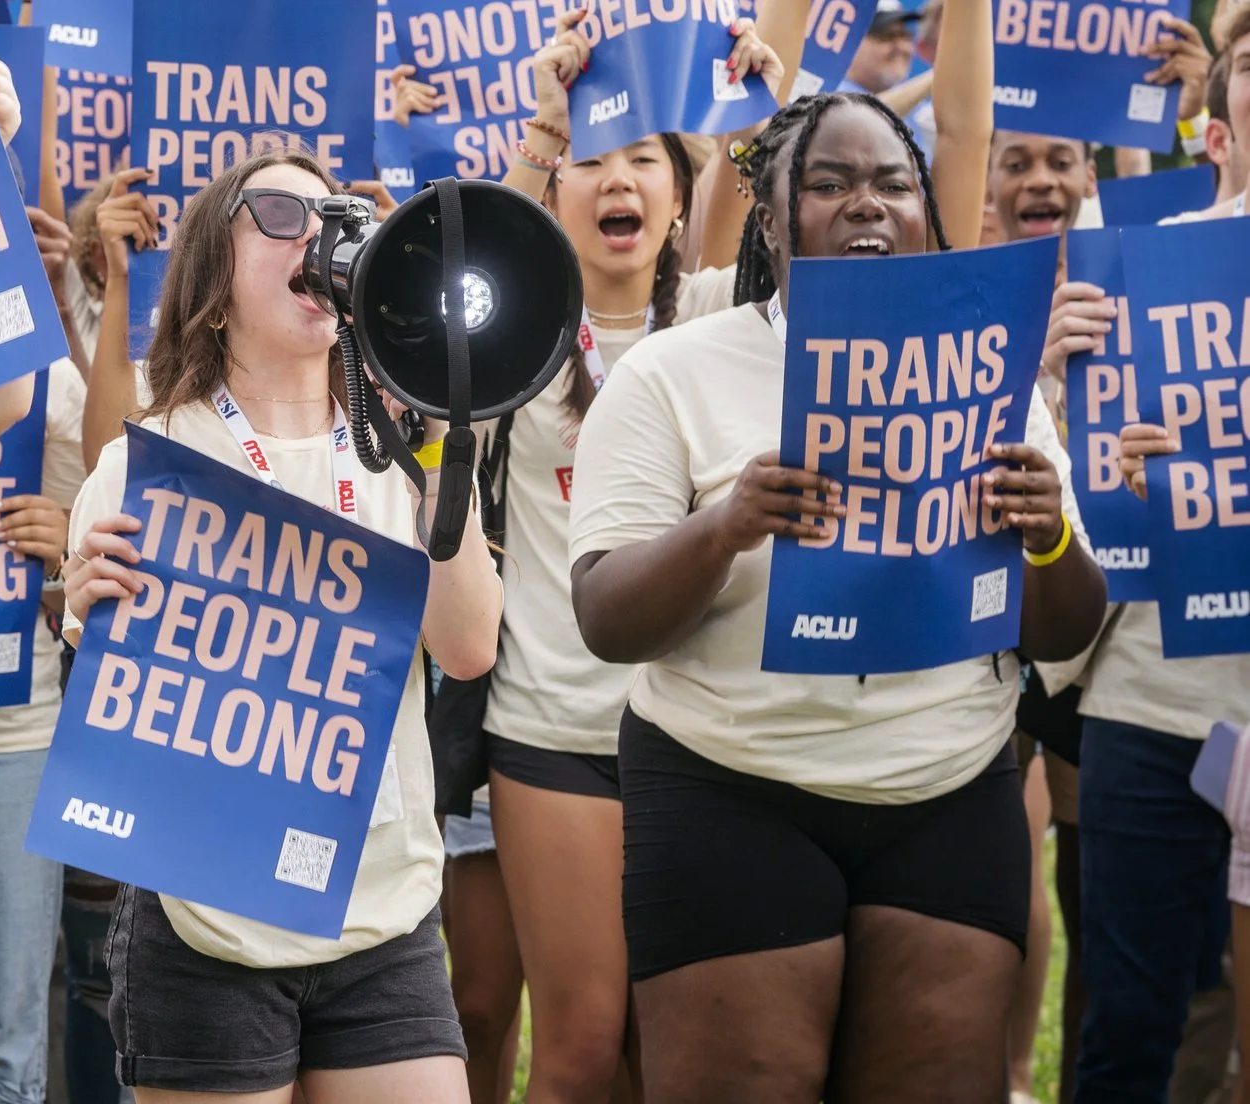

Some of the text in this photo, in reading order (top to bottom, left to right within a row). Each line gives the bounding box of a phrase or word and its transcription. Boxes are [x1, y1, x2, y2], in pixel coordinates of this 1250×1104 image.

[48, 23, 98, 48] ACLU
[146, 61, 328, 128] TRANS
[588, 90, 629, 126] ACLU
[806, 324, 1008, 406] TRANS
[243, 439, 270, 472] ACLU
[803, 393, 1013, 484] PEOPLE
[338, 480, 355, 514] ACLU
[139, 487, 368, 615] TRANS
[1095, 546, 1149, 570] ACLU
[1185, 590, 1250, 622] ACLU
[108, 572, 377, 708] PEOPLE
[791, 614, 857, 640] ACLU
[85, 651, 365, 797] BELONG
[62, 796, 135, 839] ACLU
